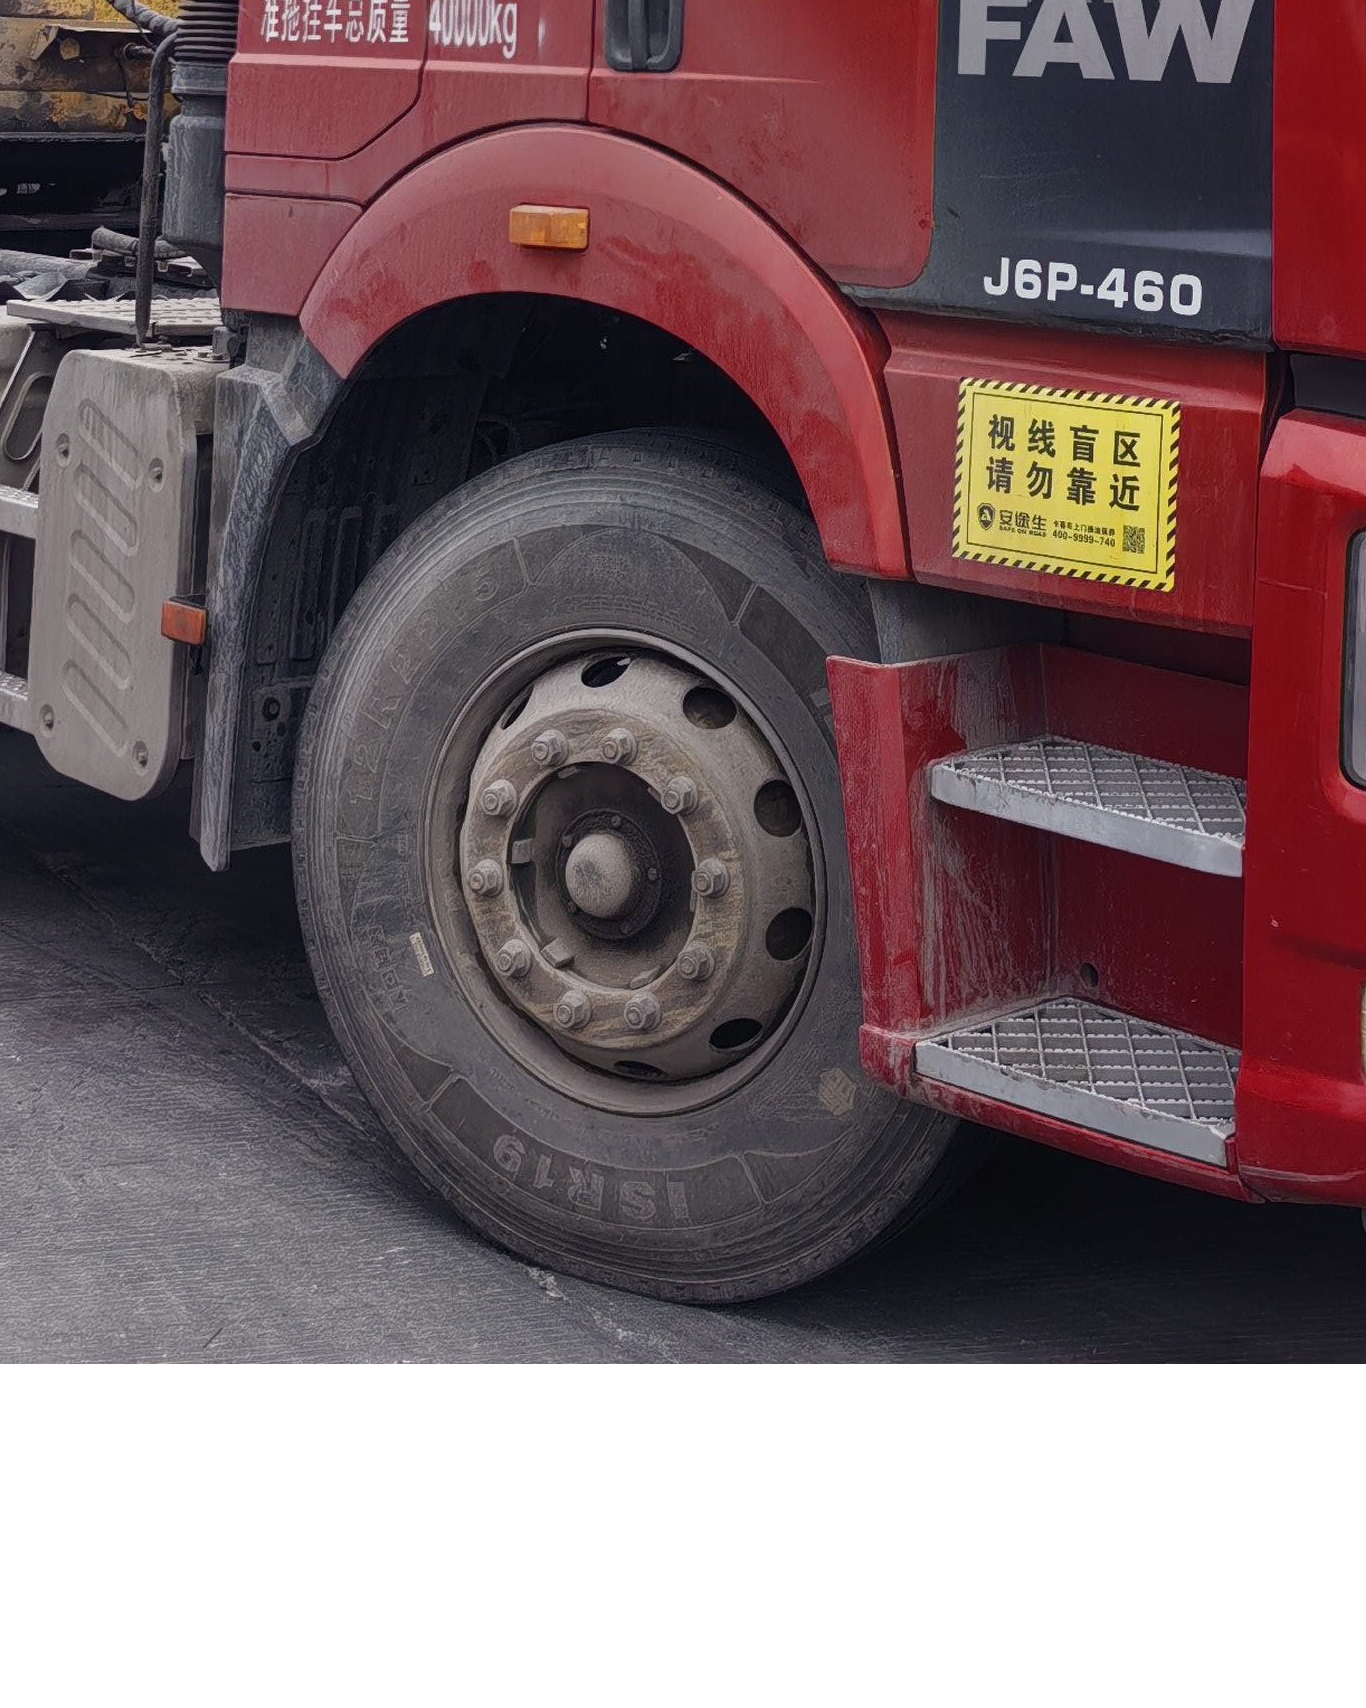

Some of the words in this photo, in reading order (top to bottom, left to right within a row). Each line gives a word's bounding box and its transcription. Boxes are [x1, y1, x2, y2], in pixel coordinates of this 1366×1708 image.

[984, 257, 1203, 316] J6P-460
[987, 413, 1141, 468] 视线盲区
[985, 456, 1141, 512] 请勿靠近
